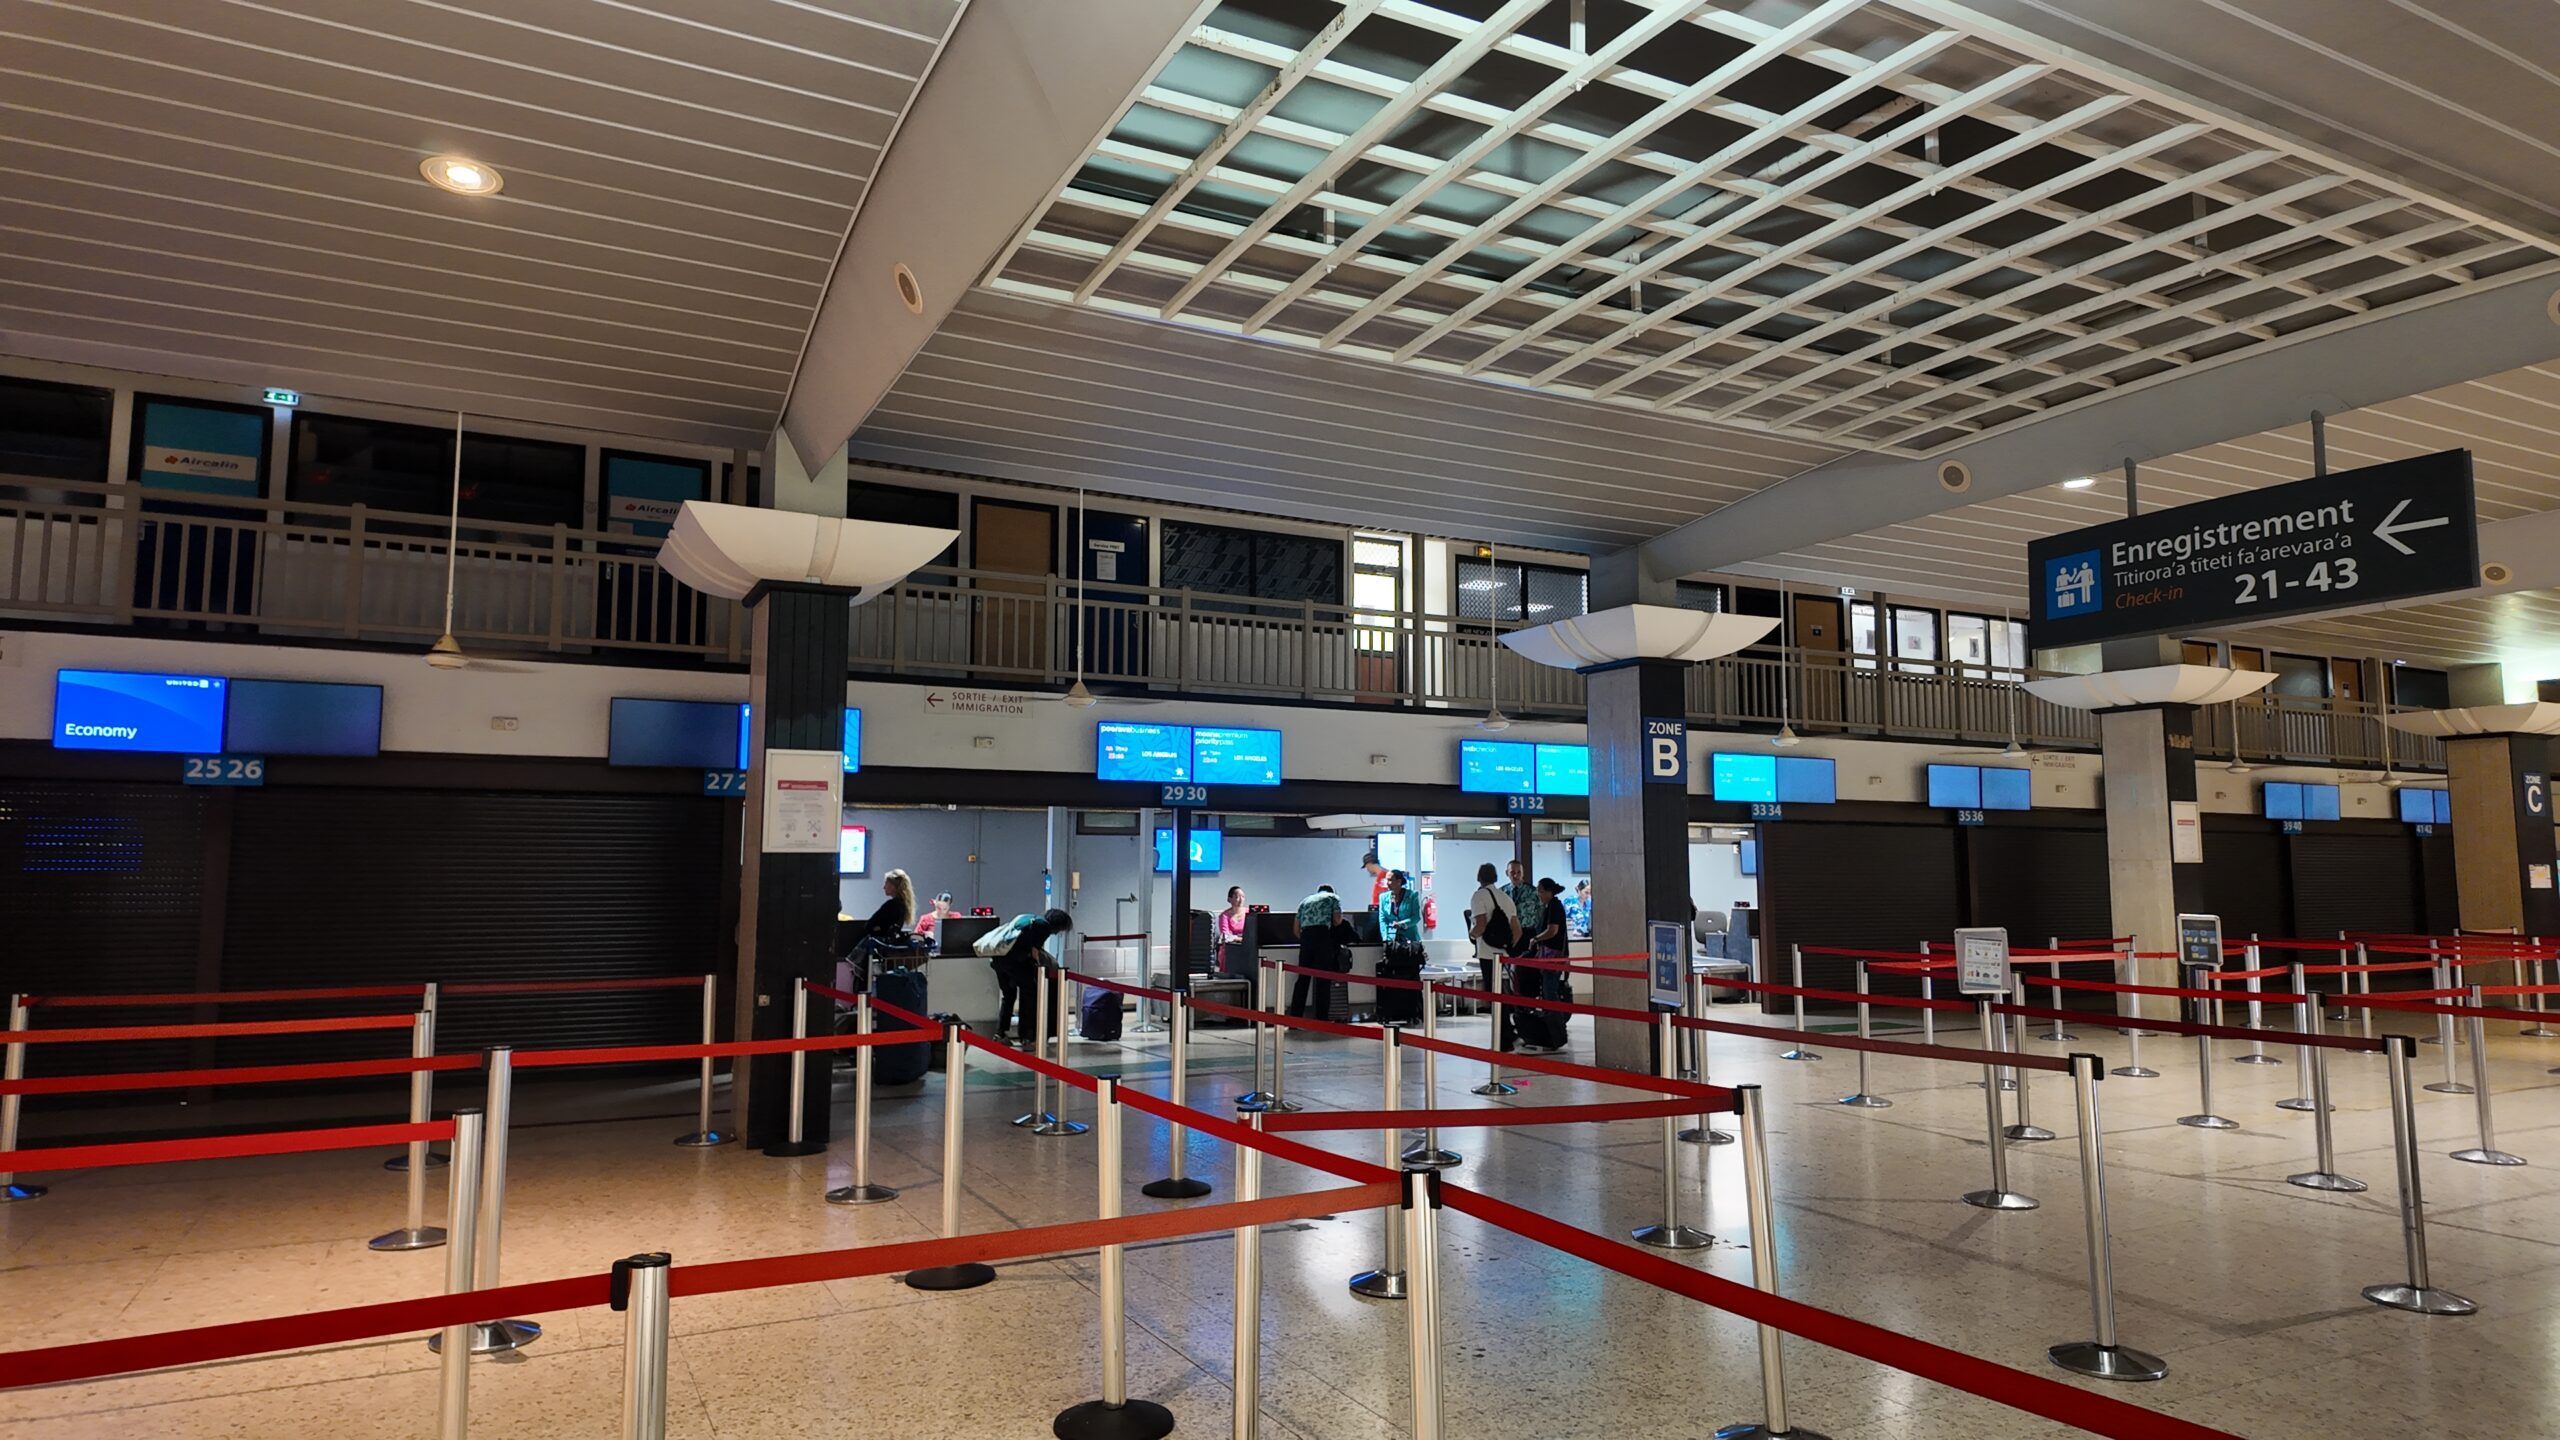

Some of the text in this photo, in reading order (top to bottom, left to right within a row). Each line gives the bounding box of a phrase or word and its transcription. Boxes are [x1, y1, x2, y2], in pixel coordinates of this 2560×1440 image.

[180, 457, 240, 470] Aircalin
[638, 504, 680, 515] Aircali
[2112, 499, 2355, 566] Enregistrement
[2237, 532, 2352, 565] fa'arevara'a
[2234, 557, 2359, 604] 21-43
[2115, 586, 2183, 608] Check-in
[952, 691, 986, 701] SORTIE
[1002, 695, 1023, 703] EXIT
[952, 703, 1023, 713] IMMIGRATION
[65, 723, 137, 740] Economy
[1649, 722, 1682, 735] ZONE
[1652, 738, 1680, 776] B
[187, 758, 262, 780] 25 26
[707, 772, 746, 790] 27 2
[2525, 775, 2541, 784] ZONE
[1164, 785, 1206, 801] 29 30
[2528, 785, 2543, 813] C
[1510, 796, 1544, 809] 31 32
[1753, 803, 1782, 816] 33 34
[1959, 810, 1984, 822] 35 36
